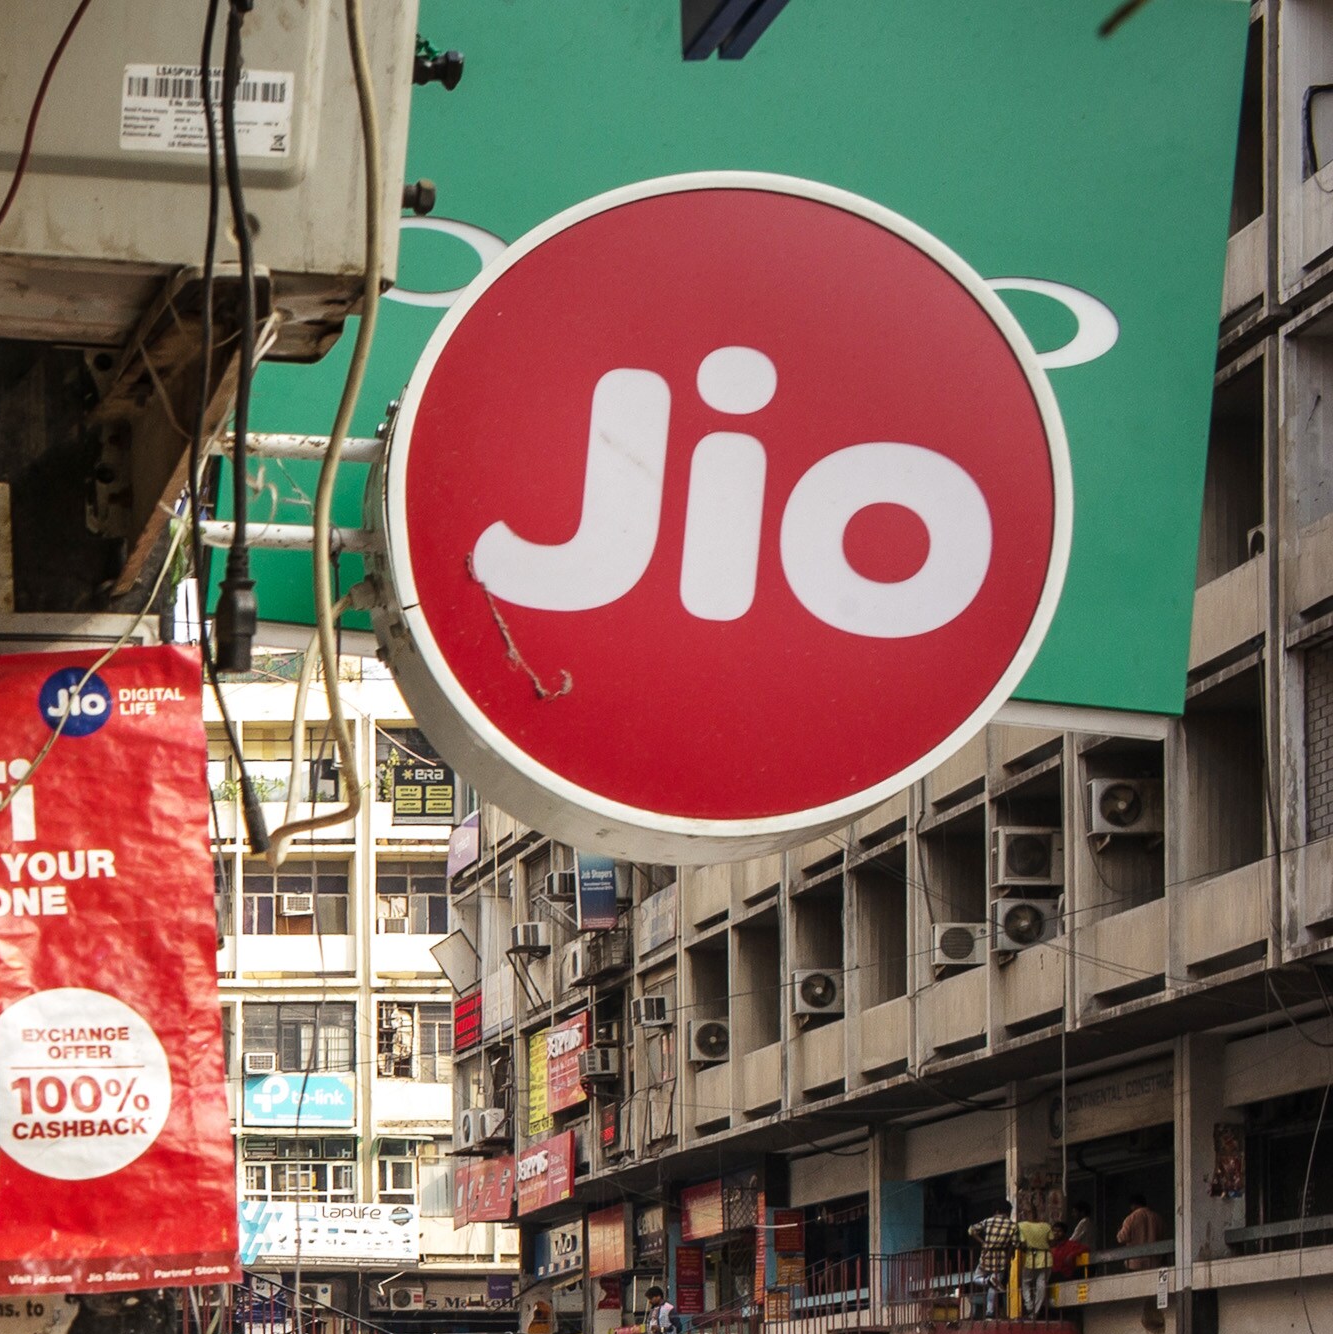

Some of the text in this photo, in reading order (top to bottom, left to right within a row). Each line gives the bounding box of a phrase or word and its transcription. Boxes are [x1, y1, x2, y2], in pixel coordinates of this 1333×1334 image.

[472, 345, 992, 638] Jio
[47, 685, 107, 717] Jio
[118, 687, 185, 702] DIGITAL
[119, 701, 157, 716] LIFE
[22, 1026, 130, 1043] EXCHANGE
[47, 1043, 113, 1061] OFFER
[10, 1075, 150, 1116] 100%
[11, 1117, 149, 1141] CASHBACK
[105, 1270, 141, 1282] Stores
[154, 1265, 230, 1279] Partner Stores
[26, 1301, 45, 1317] to
